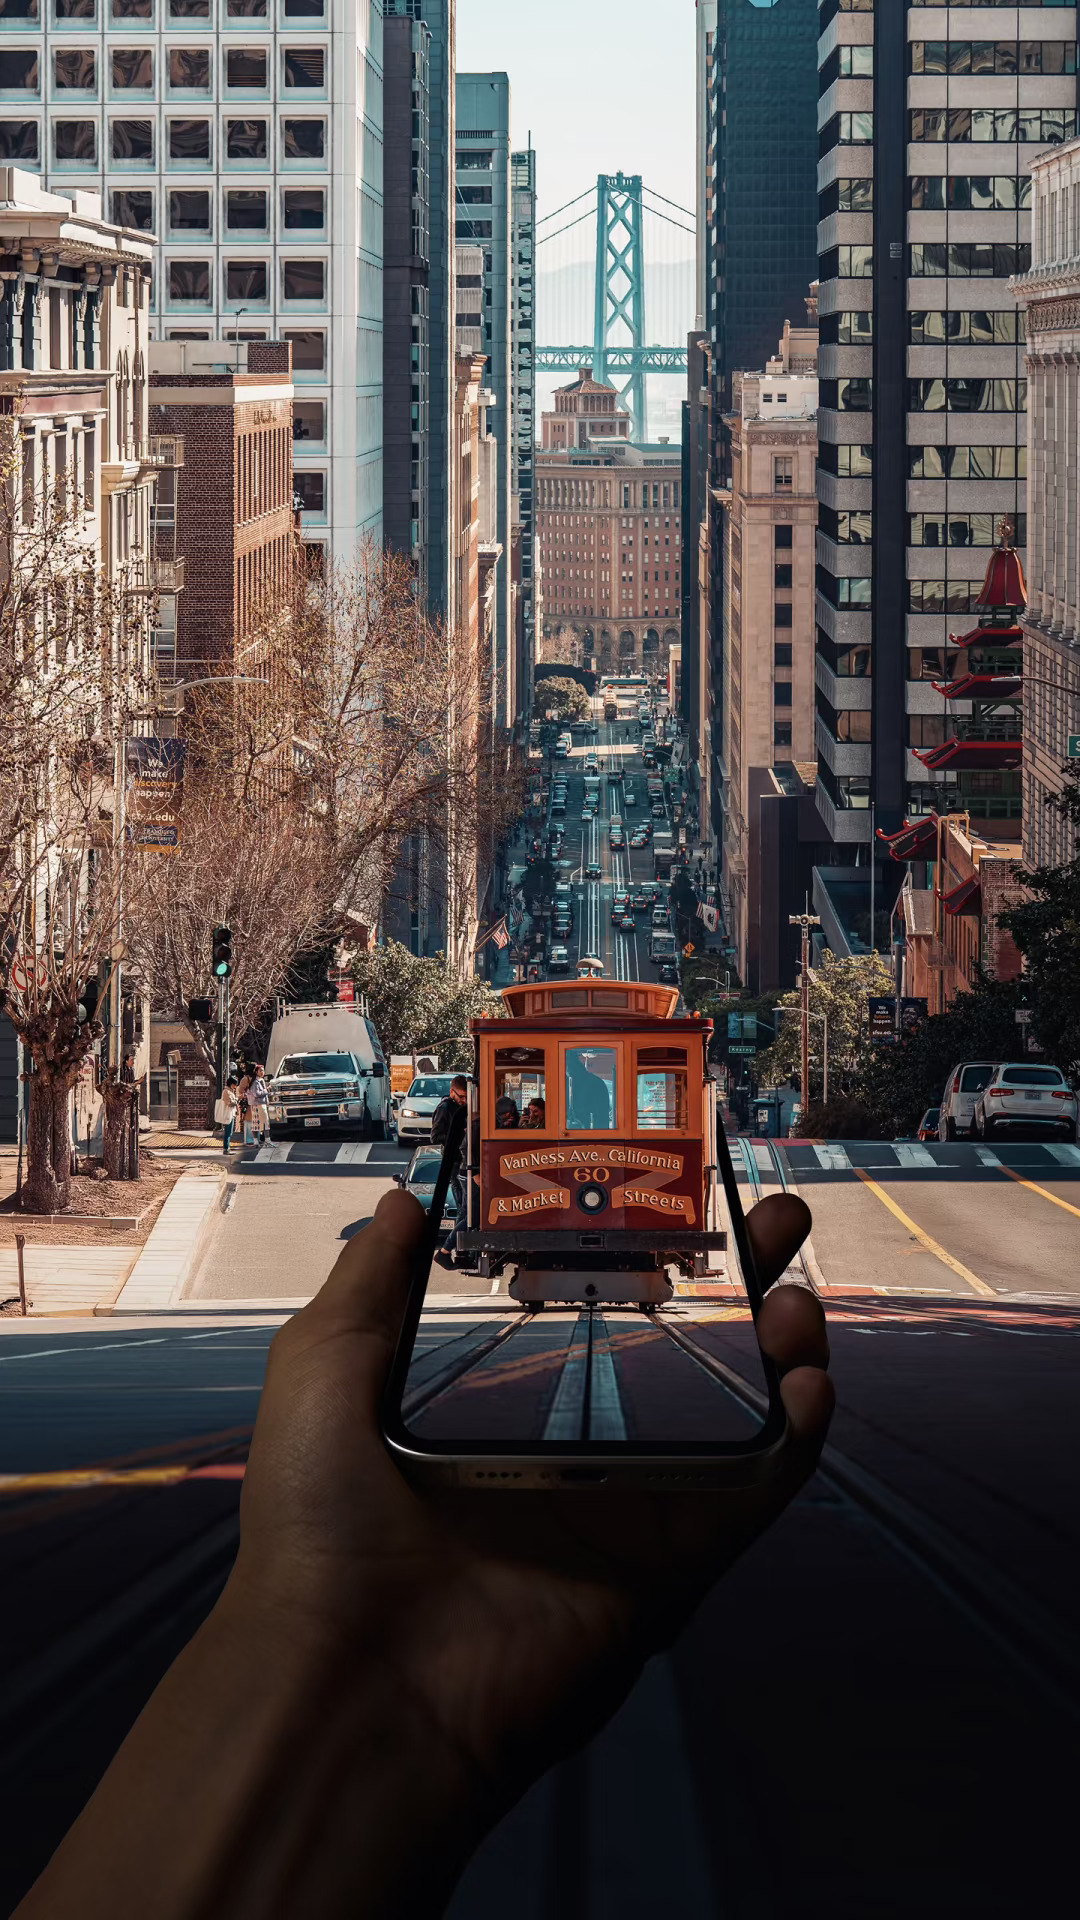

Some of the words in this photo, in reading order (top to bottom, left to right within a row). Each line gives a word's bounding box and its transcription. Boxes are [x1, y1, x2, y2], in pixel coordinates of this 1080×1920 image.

[142, 770, 168, 778] make
[504, 1155, 529, 1170] Van
[530, 1152, 565, 1167] Ness
[608, 1149, 681, 1170] California
[573, 1167, 610, 1183] 60
[497, 1199, 508, 1212] &
[511, 1191, 564, 1211] Market
[624, 1190, 685, 1210] Streets
